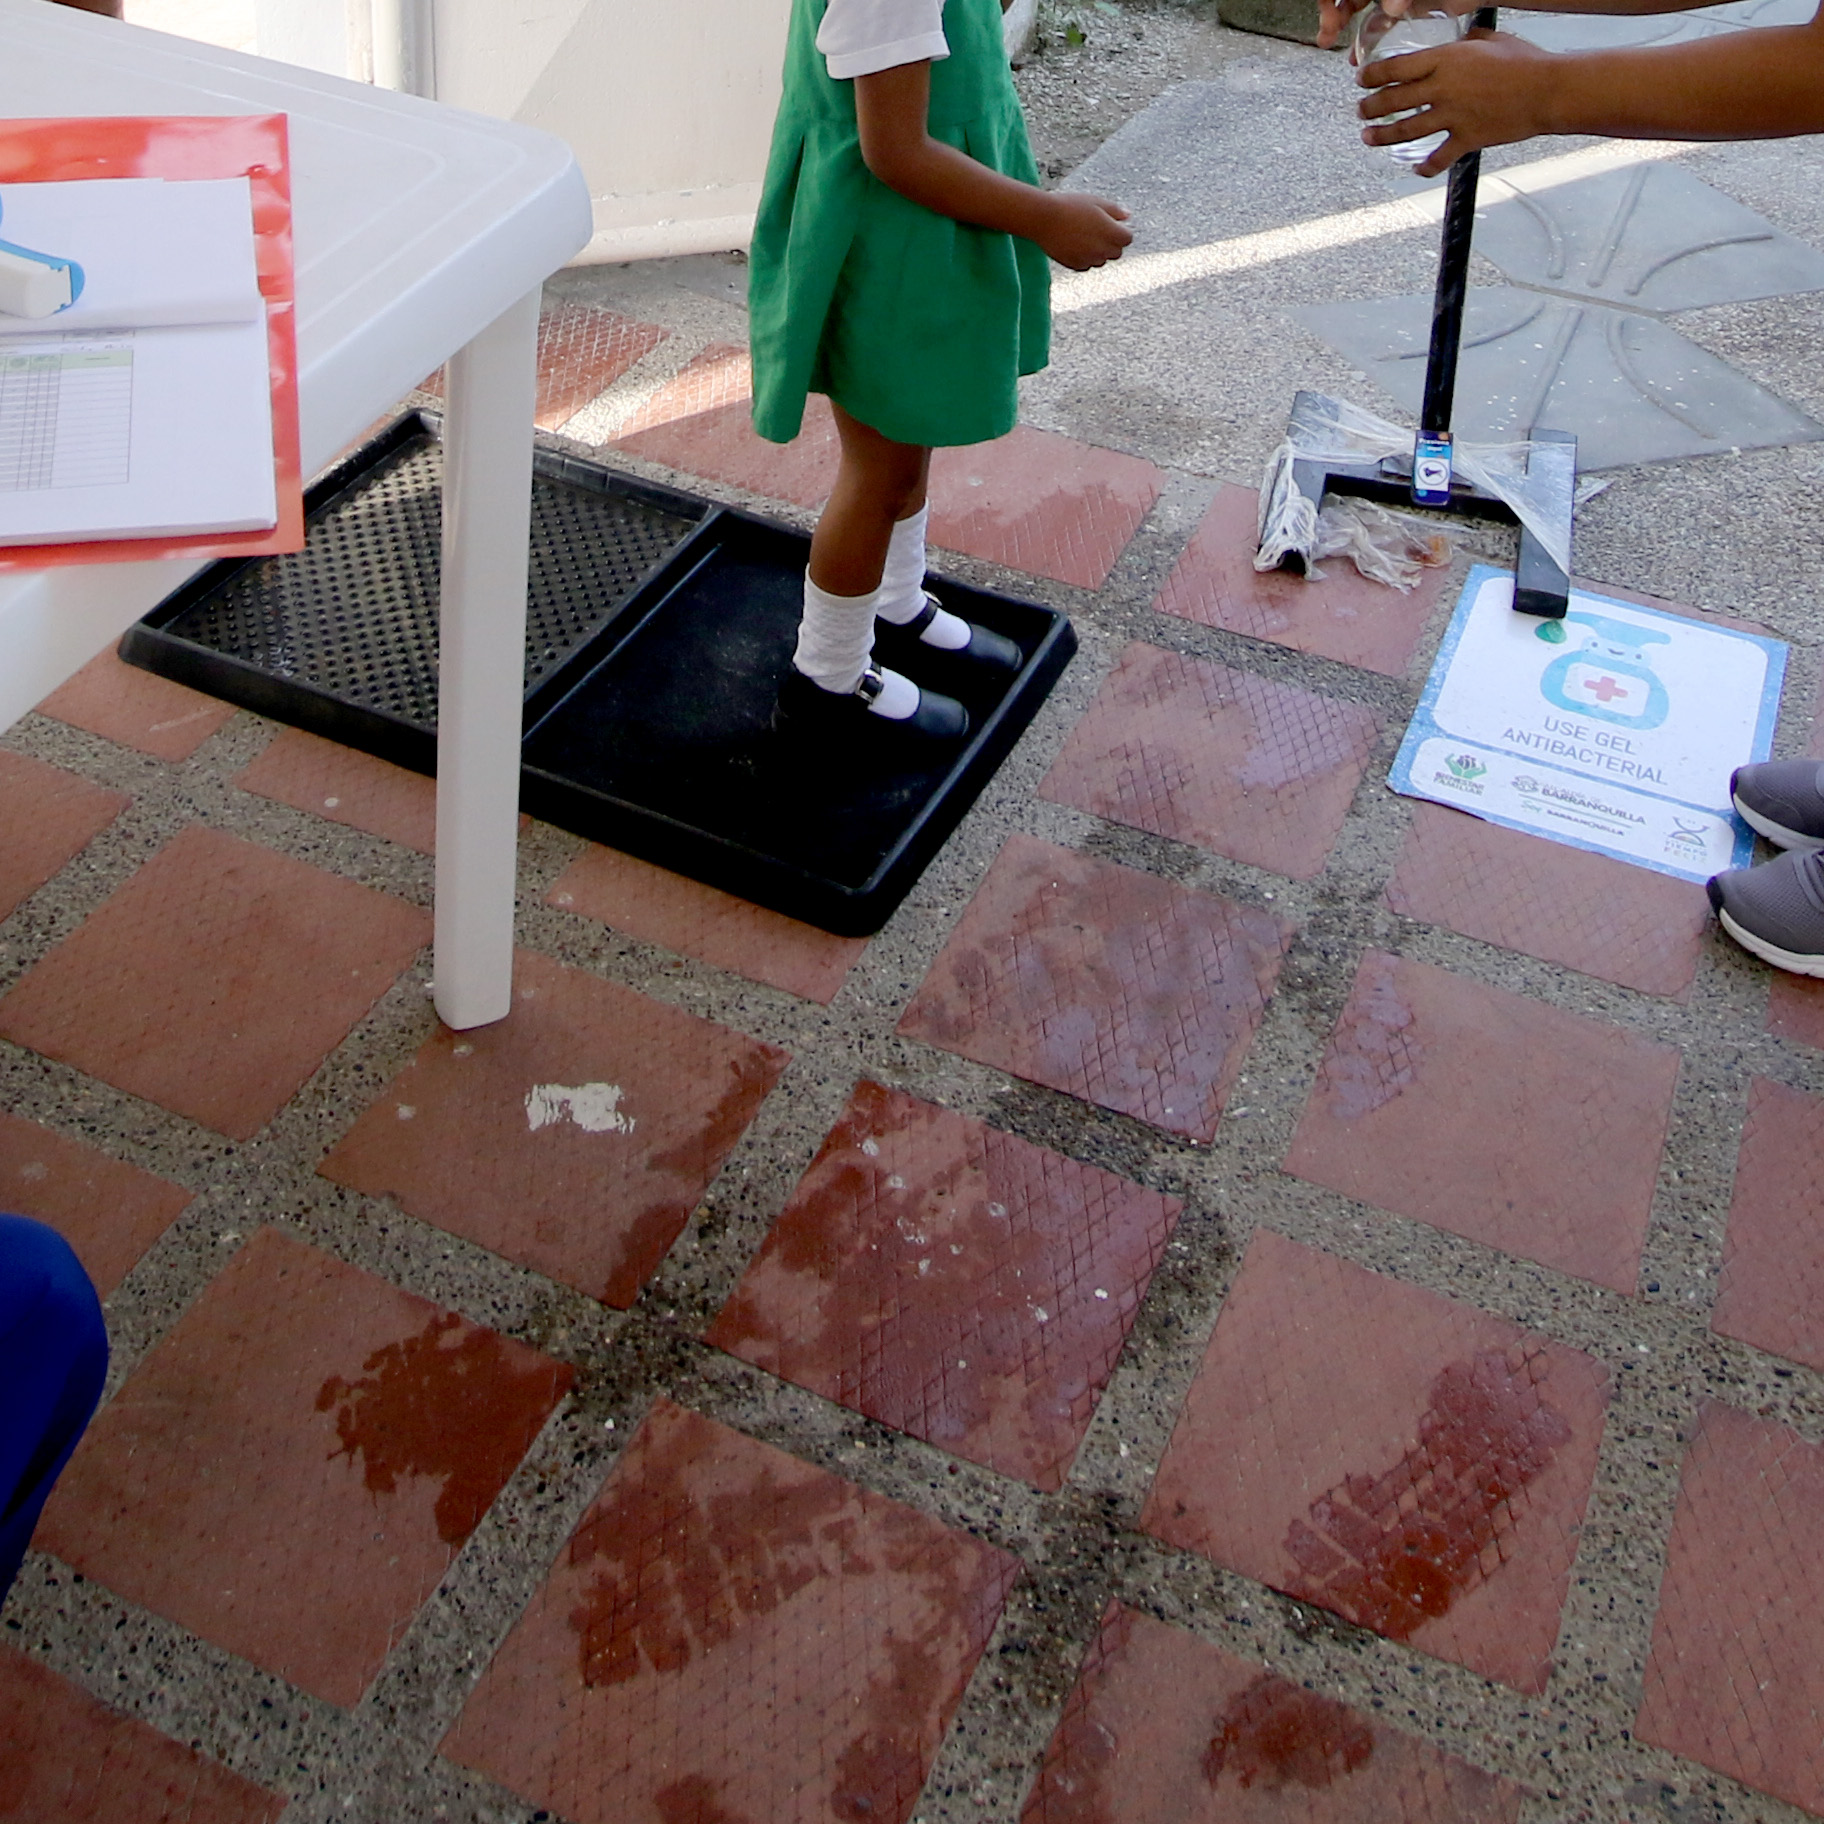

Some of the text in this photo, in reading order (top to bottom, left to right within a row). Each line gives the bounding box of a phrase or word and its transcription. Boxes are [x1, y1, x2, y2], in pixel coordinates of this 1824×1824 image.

[1543, 716, 1637, 756] USE GEL
[1501, 727, 1668, 786] ANTIBACTERIAL
[1542, 788, 1646, 825] BARRANQUILLA
